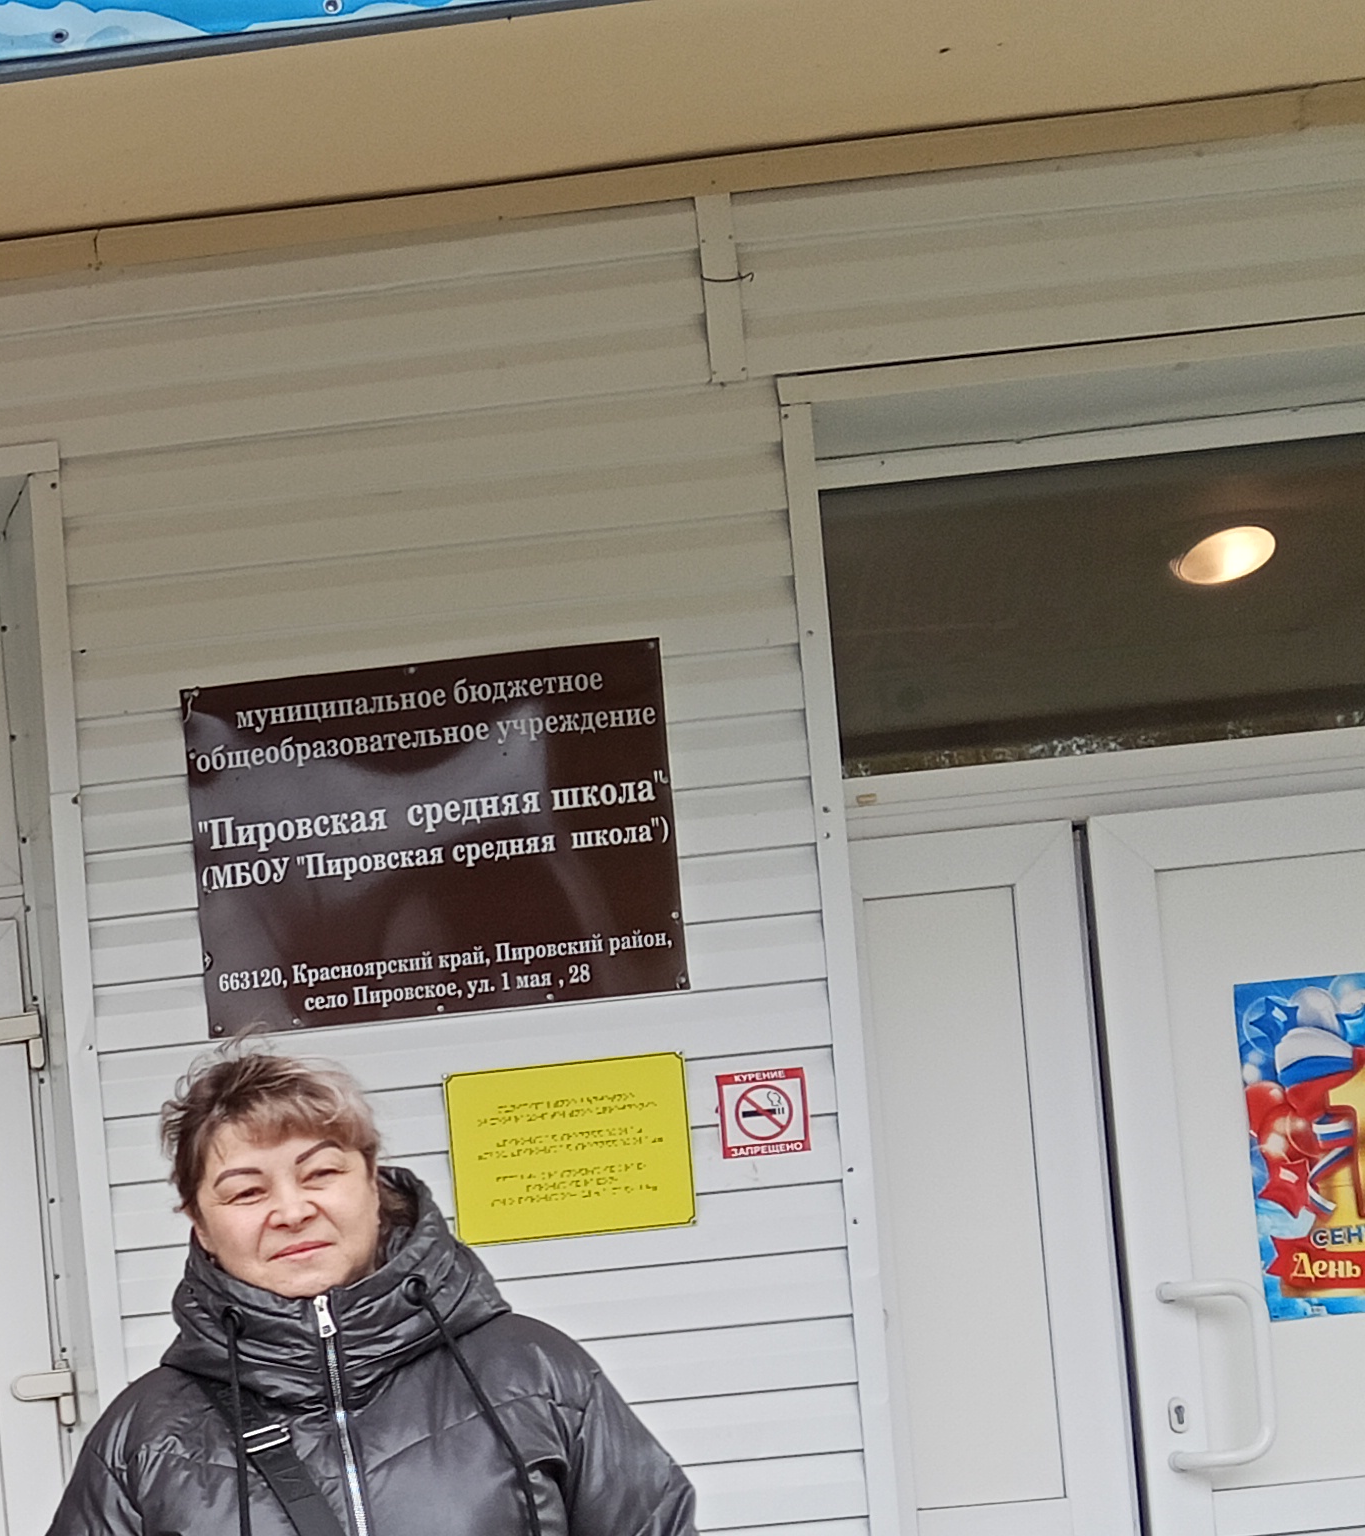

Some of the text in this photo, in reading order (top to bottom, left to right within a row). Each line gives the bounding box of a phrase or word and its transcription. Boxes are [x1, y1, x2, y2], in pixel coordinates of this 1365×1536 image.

[236, 672, 603, 733] муниципальное бюджетное
[196, 706, 656, 772] общеобразовательное учреждение
[198, 770, 664, 852] "Пировская средняя школа"
[202, 816, 669, 893] (МБОУ "Пировская средняя школа")
[218, 930, 673, 992] 663120, Красноярский край, Пировский район,
[304, 992, 348, 1011] село
[352, 981, 463, 1008] Пировское,
[466, 979, 495, 999] ул.
[501, 972, 511, 991] 1
[516, 971, 552, 989] мая
[569, 963, 591, 984] 28
[734, 1070, 786, 1083] КУРЕНИЕ
[731, 1142, 803, 1157] ЗАПРЕЩЕНО
[1311, 1224, 1365, 1247] СЕН
[1290, 1252, 1362, 1283] День
